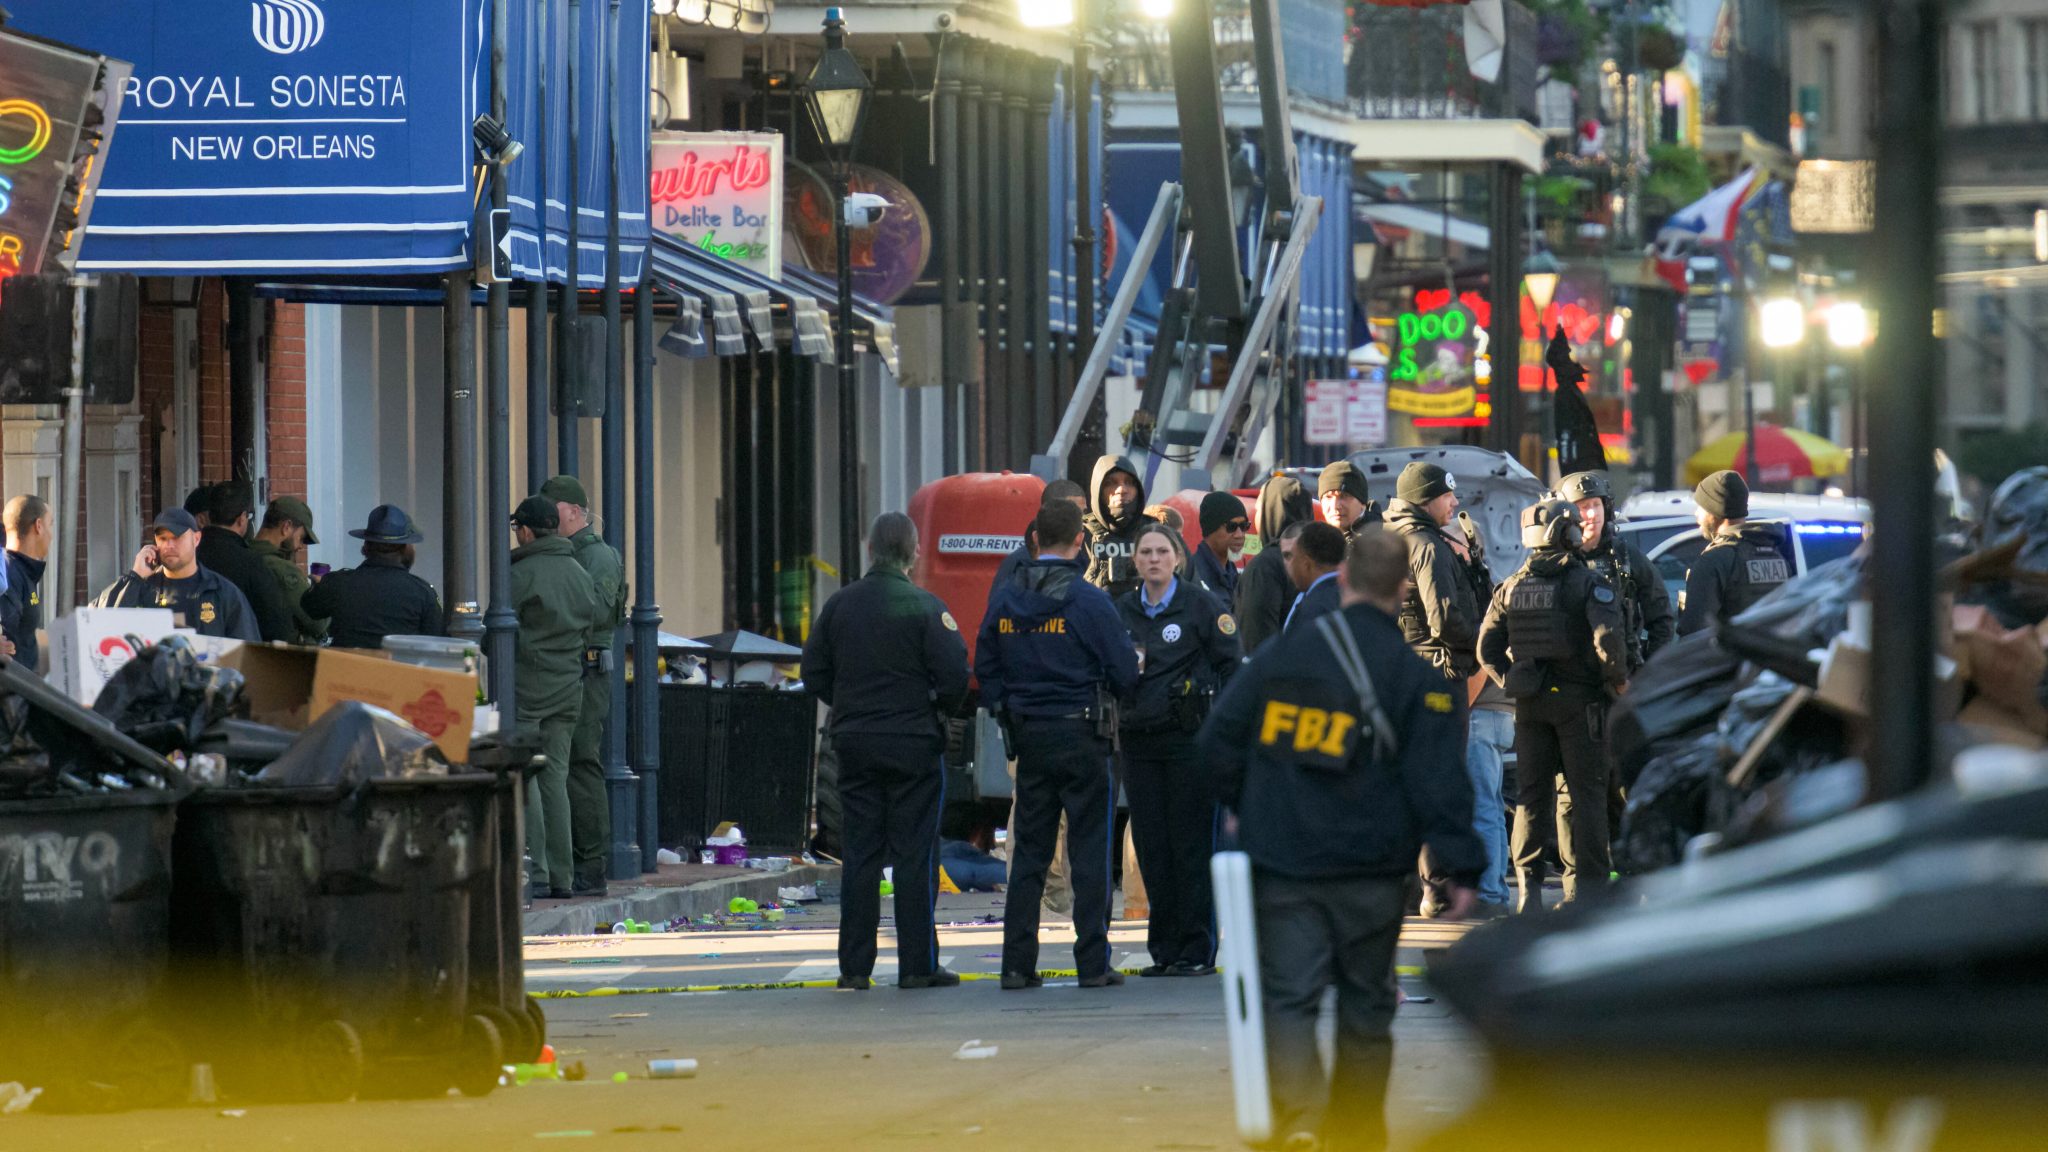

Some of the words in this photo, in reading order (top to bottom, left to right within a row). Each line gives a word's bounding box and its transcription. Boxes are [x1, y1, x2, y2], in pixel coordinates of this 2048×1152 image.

[118, 75, 255, 109] ROYAL
[270, 74, 406, 108] SONESTA
[171, 135, 244, 161] NEW
[253, 134, 376, 160] ORLEANS
[665, 205, 722, 227] Delite
[732, 204, 767, 228] Bar
[1093, 542, 1136, 558] POLI
[1511, 591, 1554, 609] OLICE
[999, 617, 1067, 634] DEIVE
[1259, 700, 1358, 758] FBI
